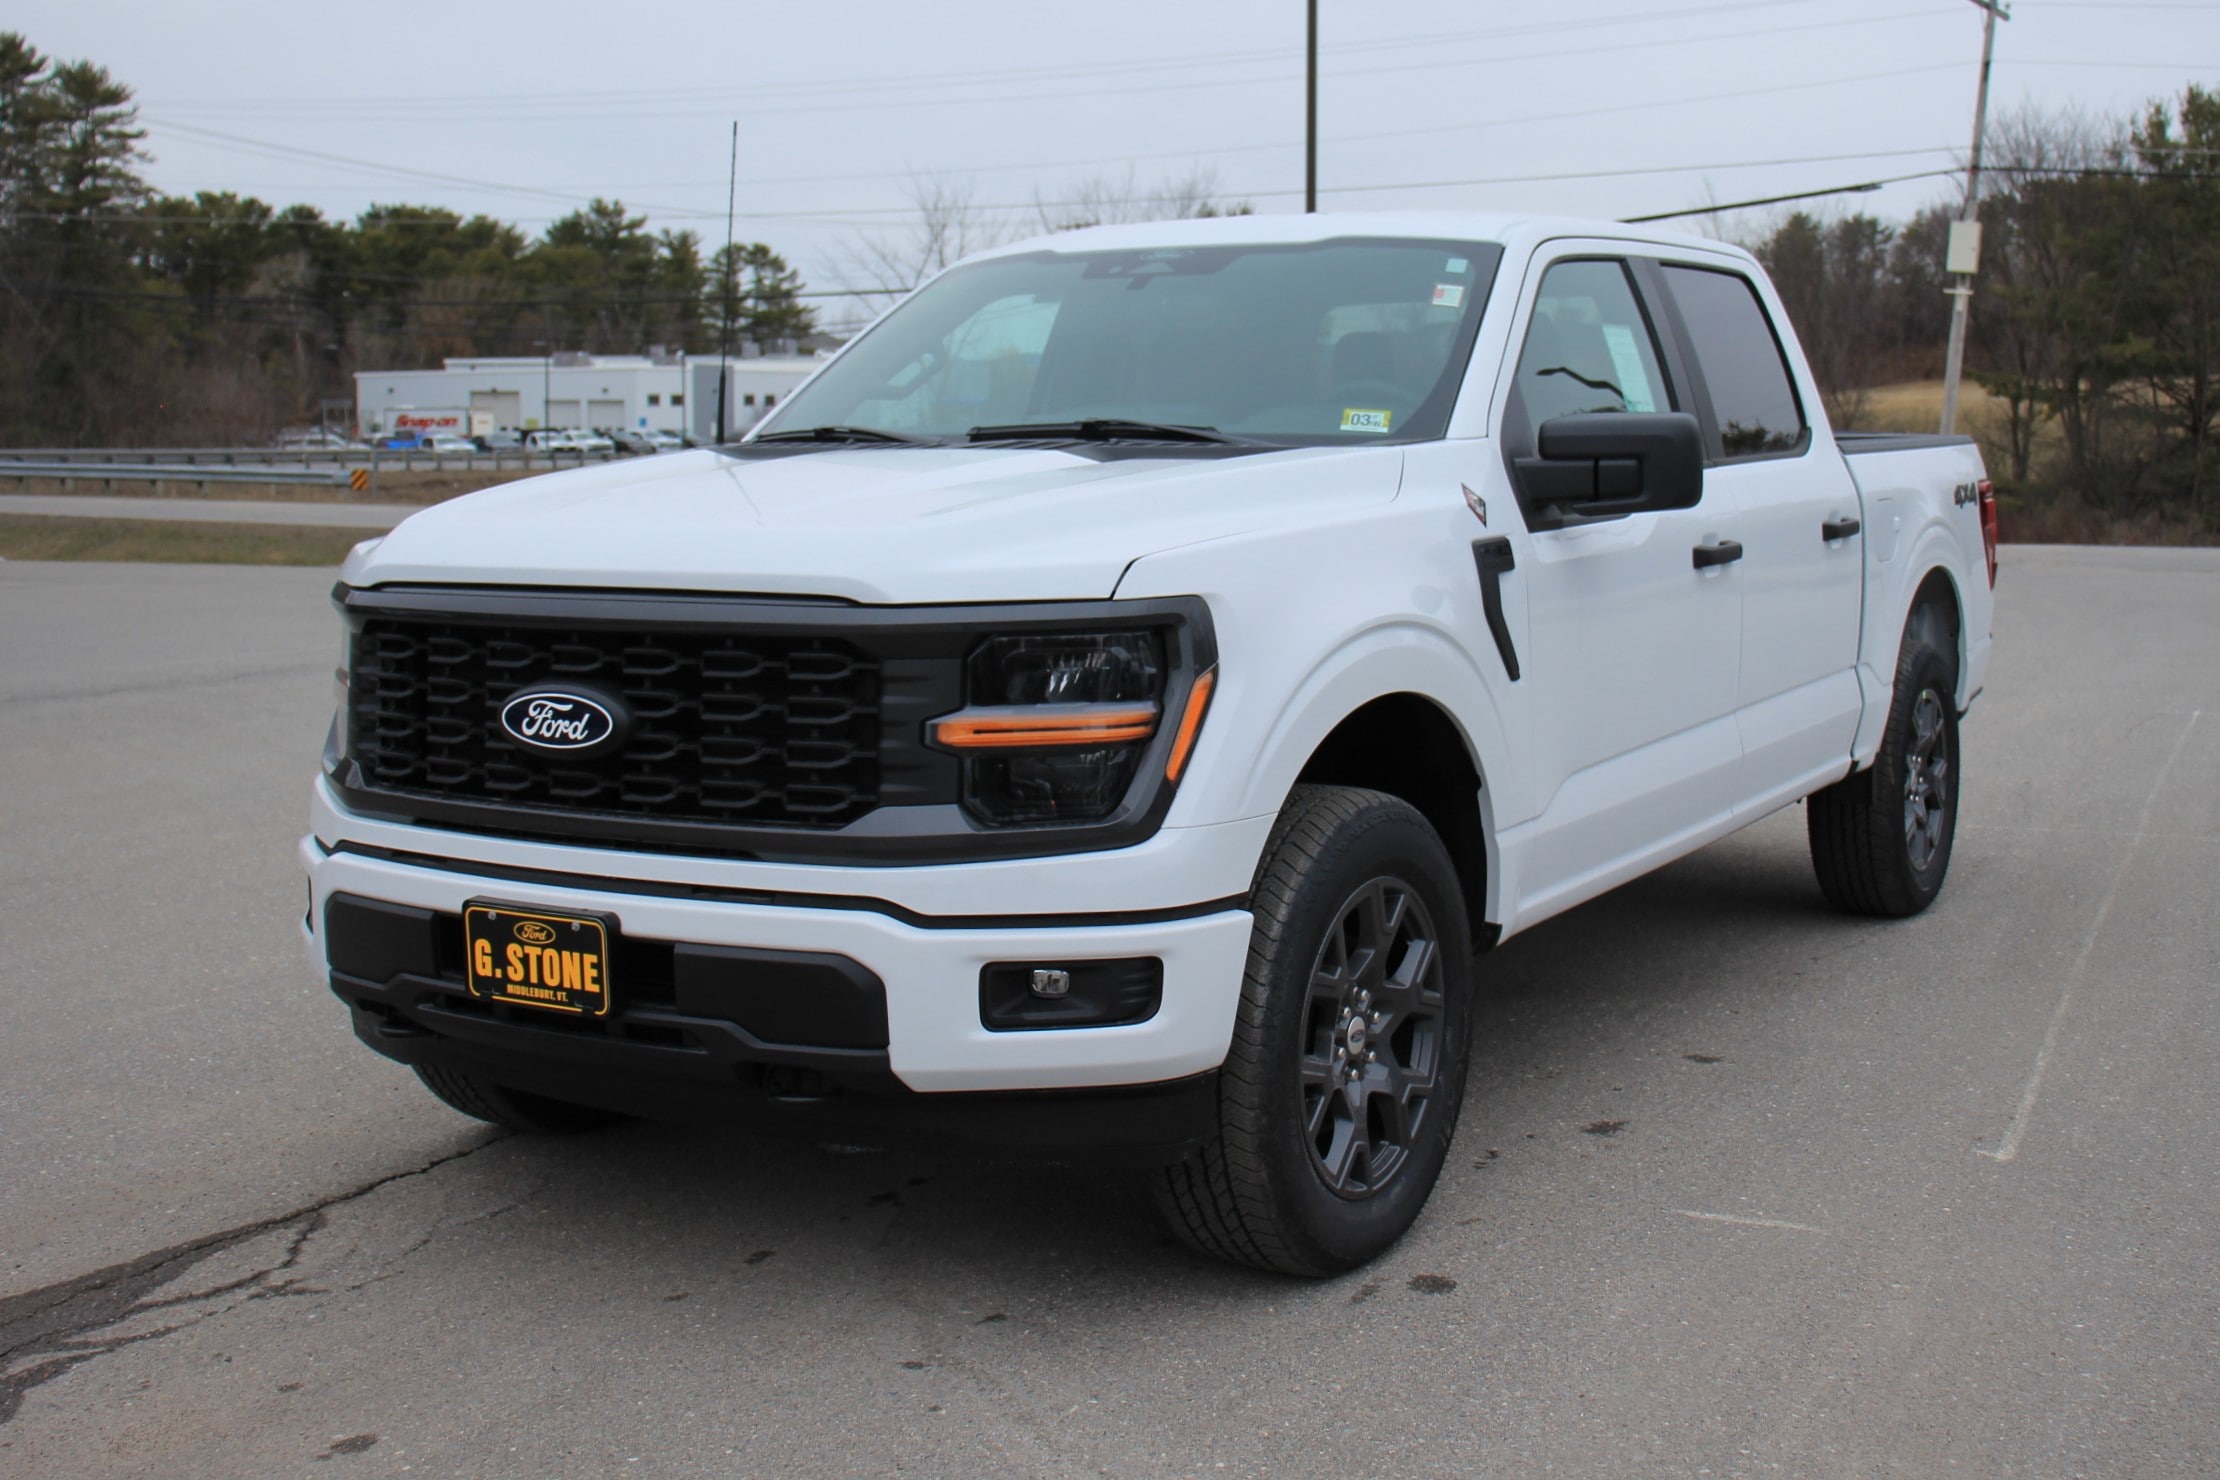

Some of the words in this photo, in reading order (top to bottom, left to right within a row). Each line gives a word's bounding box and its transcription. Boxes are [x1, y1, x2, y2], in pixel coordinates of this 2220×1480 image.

[522, 700, 590, 740] Ford
[521, 923, 547, 941] Ford
[474, 938, 502, 979] G.
[506, 943, 600, 993] STONE
